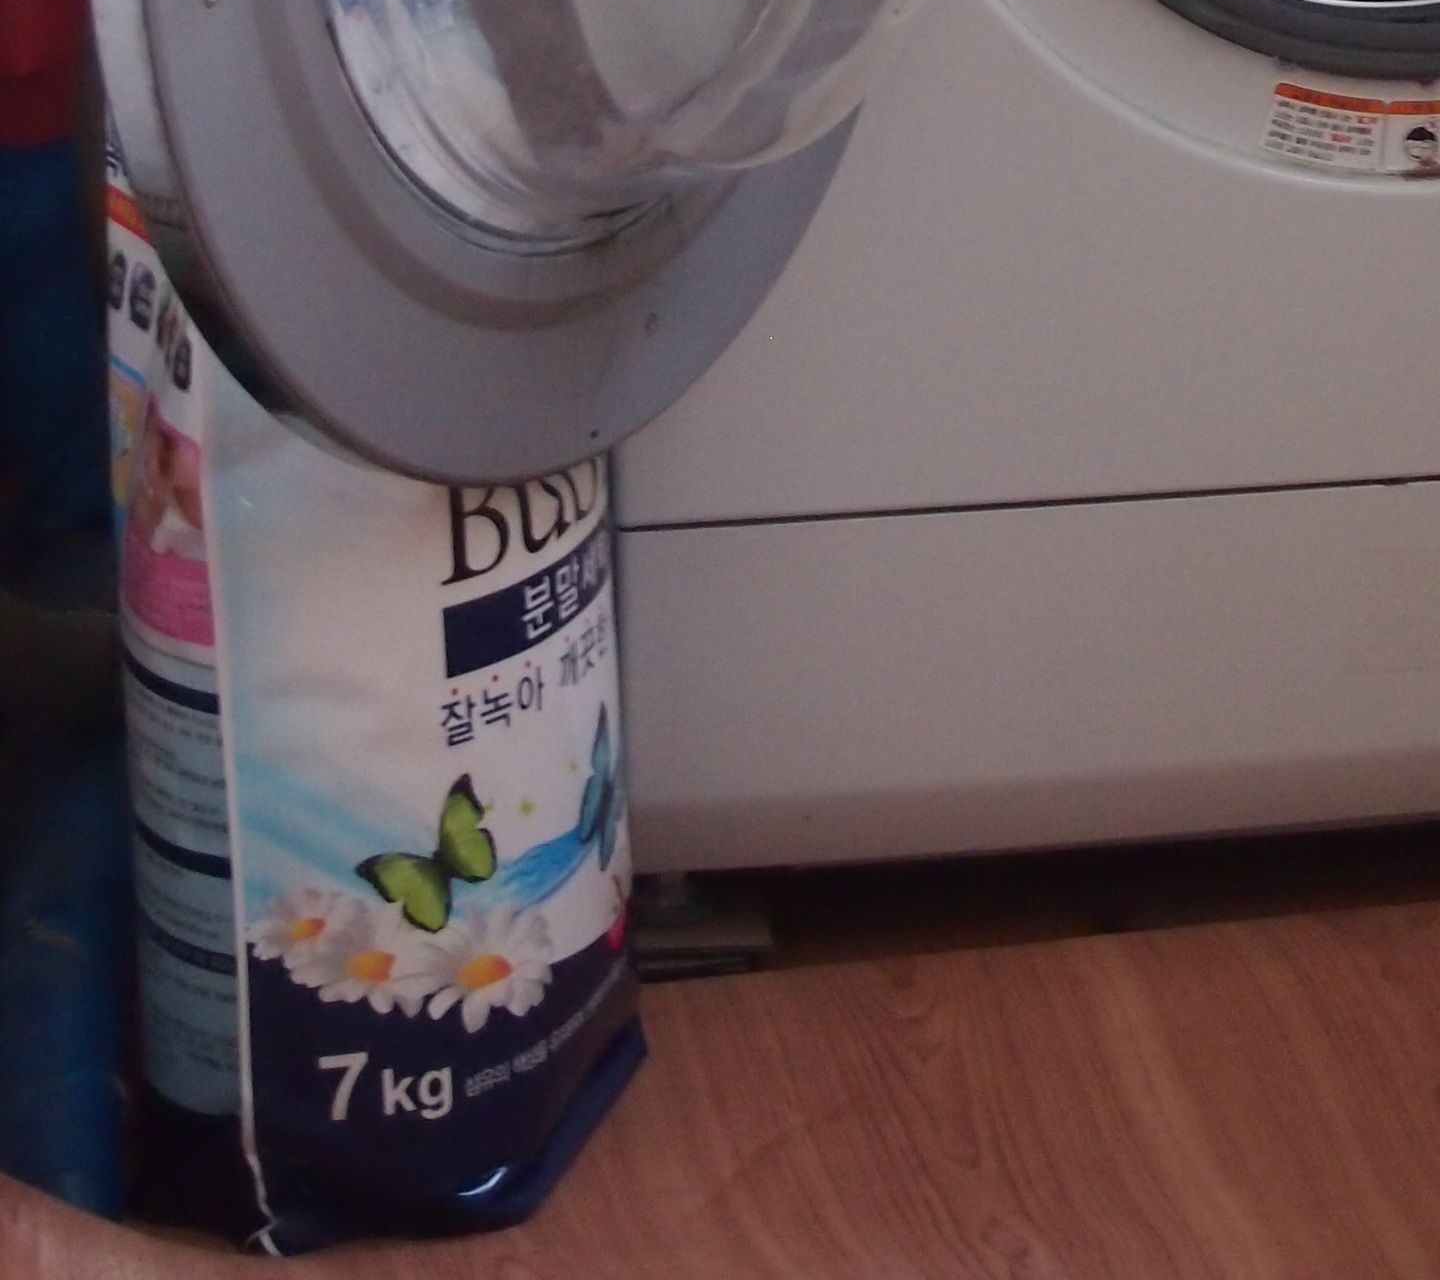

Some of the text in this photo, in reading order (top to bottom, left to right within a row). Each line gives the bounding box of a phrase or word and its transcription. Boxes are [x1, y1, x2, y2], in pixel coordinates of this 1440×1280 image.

[440, 666, 545, 747] 잘녹아
[317, 1050, 454, 1122] 7 kg
